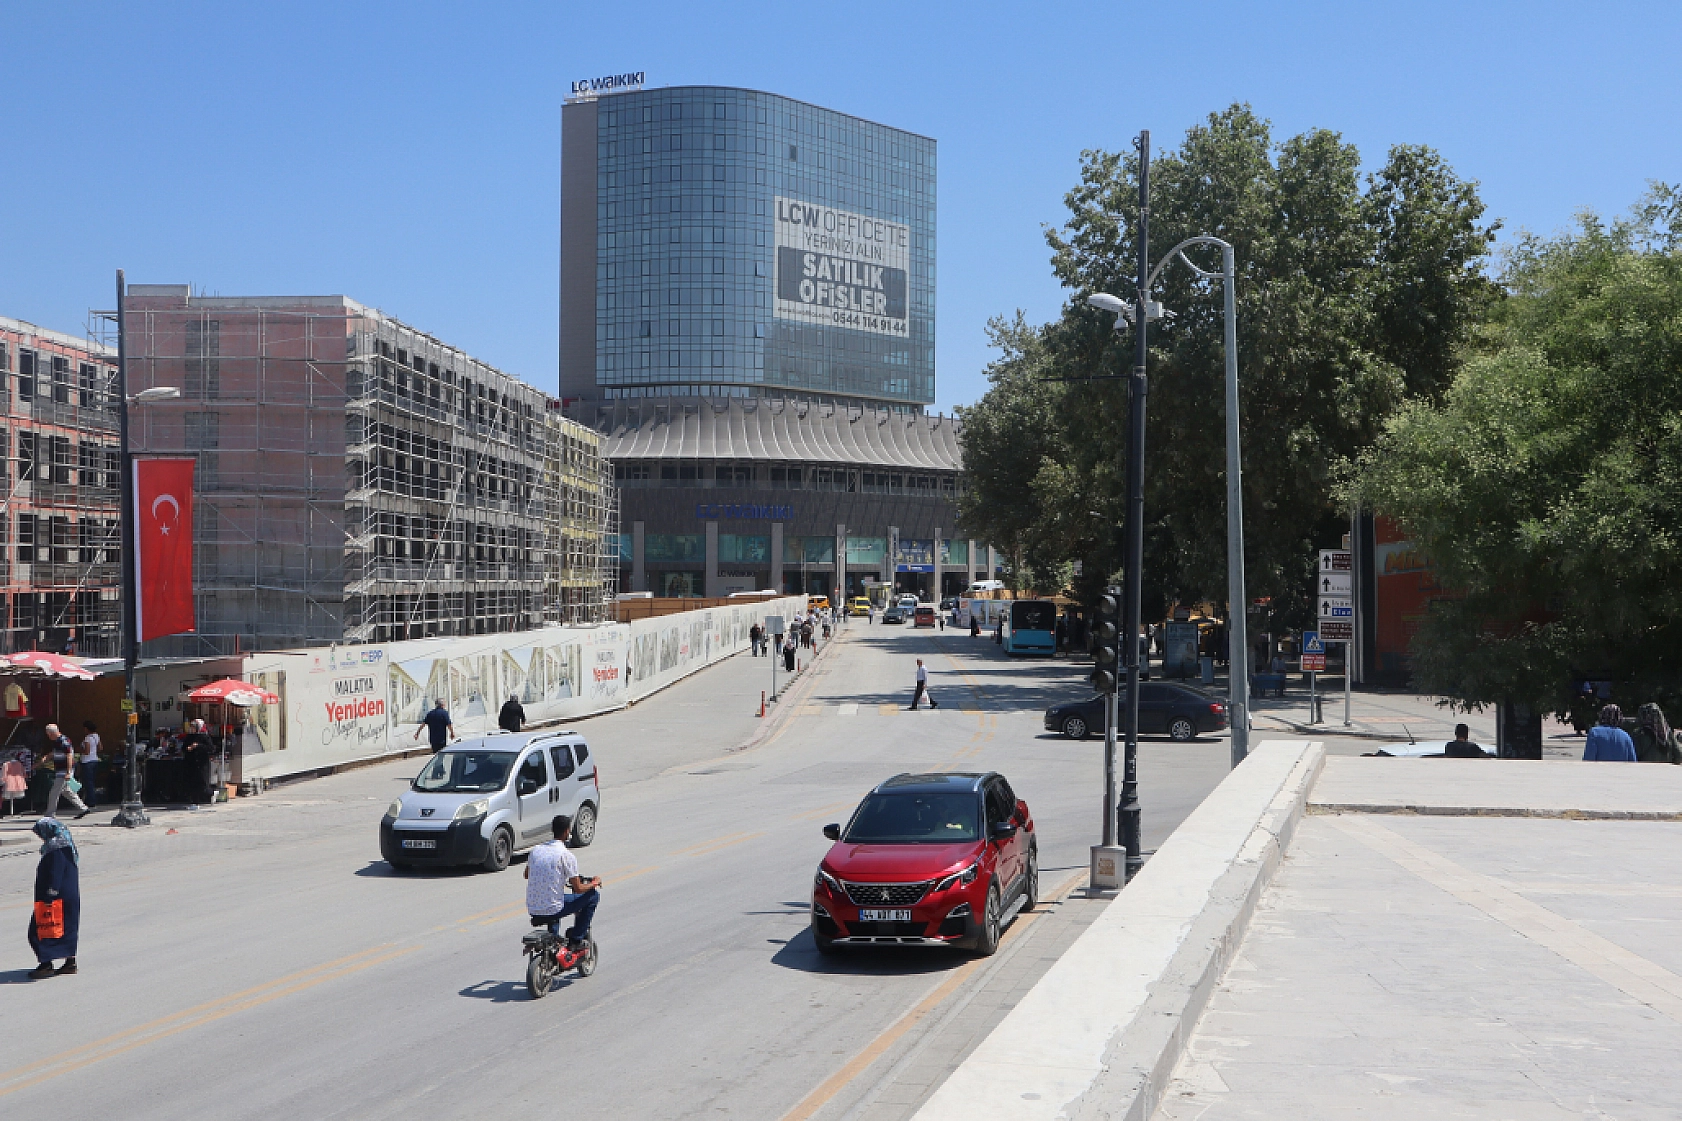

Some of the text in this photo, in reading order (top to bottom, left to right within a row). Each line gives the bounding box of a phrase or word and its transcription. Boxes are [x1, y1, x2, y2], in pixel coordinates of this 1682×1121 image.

[571, 79, 589, 93] LC
[778, 200, 820, 228] LCW
[802, 252, 885, 291] SATILIK
[799, 278, 887, 316] OFİSLER
[833, 311, 860, 326] 0544
[696, 504, 720, 519] LC
[334, 677, 374, 696] MALATYA
[325, 696, 385, 722] Yeniden
